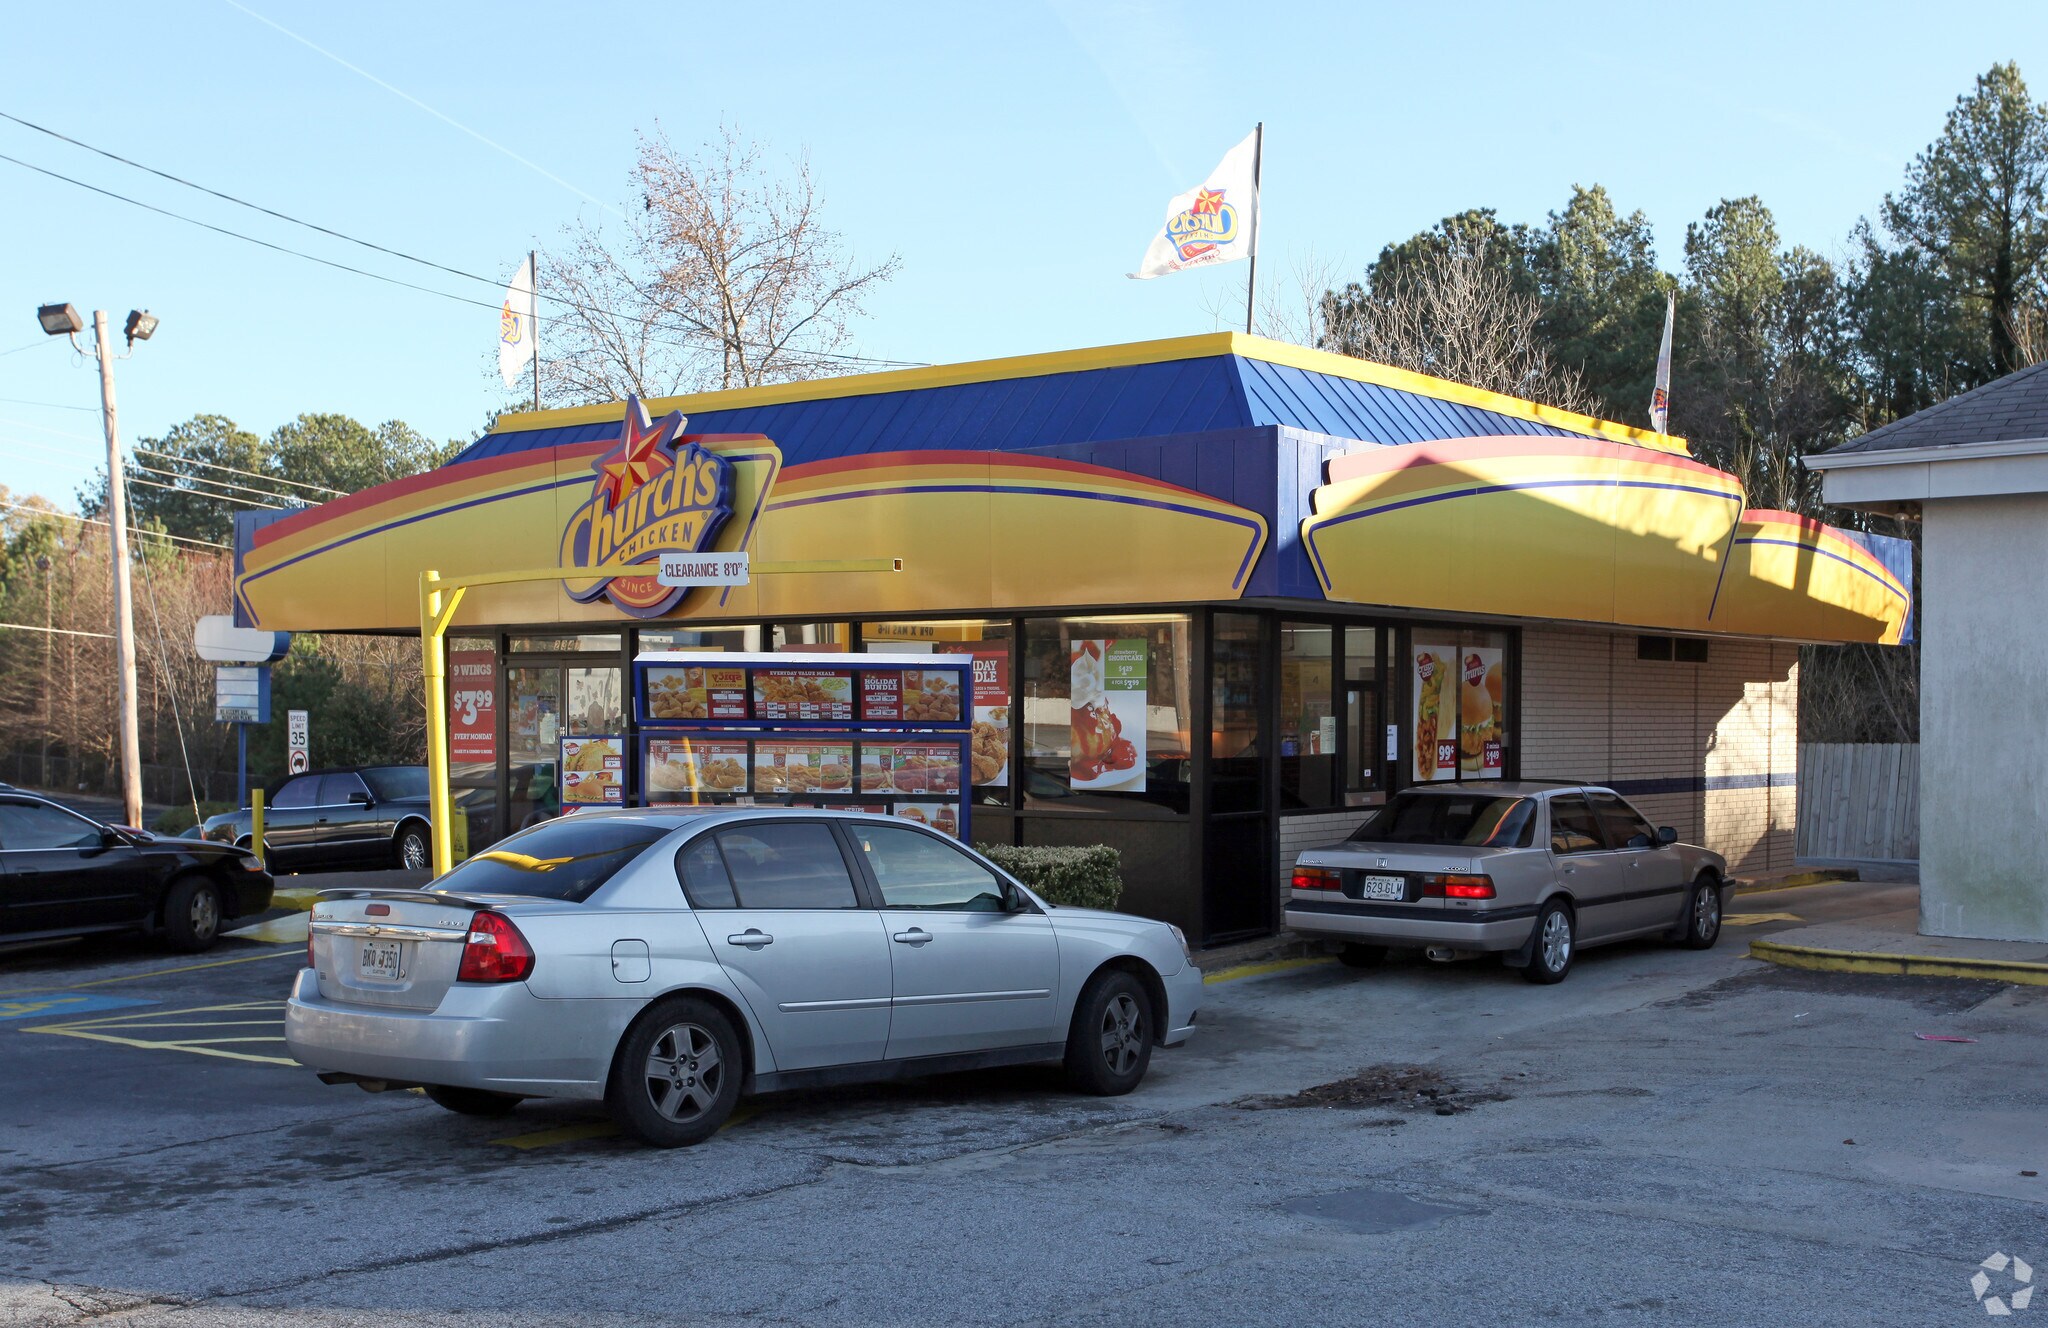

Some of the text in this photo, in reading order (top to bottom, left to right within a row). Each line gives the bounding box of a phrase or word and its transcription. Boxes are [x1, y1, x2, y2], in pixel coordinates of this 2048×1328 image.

[562, 450, 717, 575] Church's
[619, 521, 693, 562] CHICKEN
[664, 563, 718, 578] CLEARANCE
[620, 580, 653, 594] SINCE
[453, 664, 492, 676] 9 WINGS
[973, 660, 998, 671] IDAY
[291, 732, 306, 745] 35
[1438, 744, 1455, 761] 99¢
[1366, 881, 1383, 893] 629
